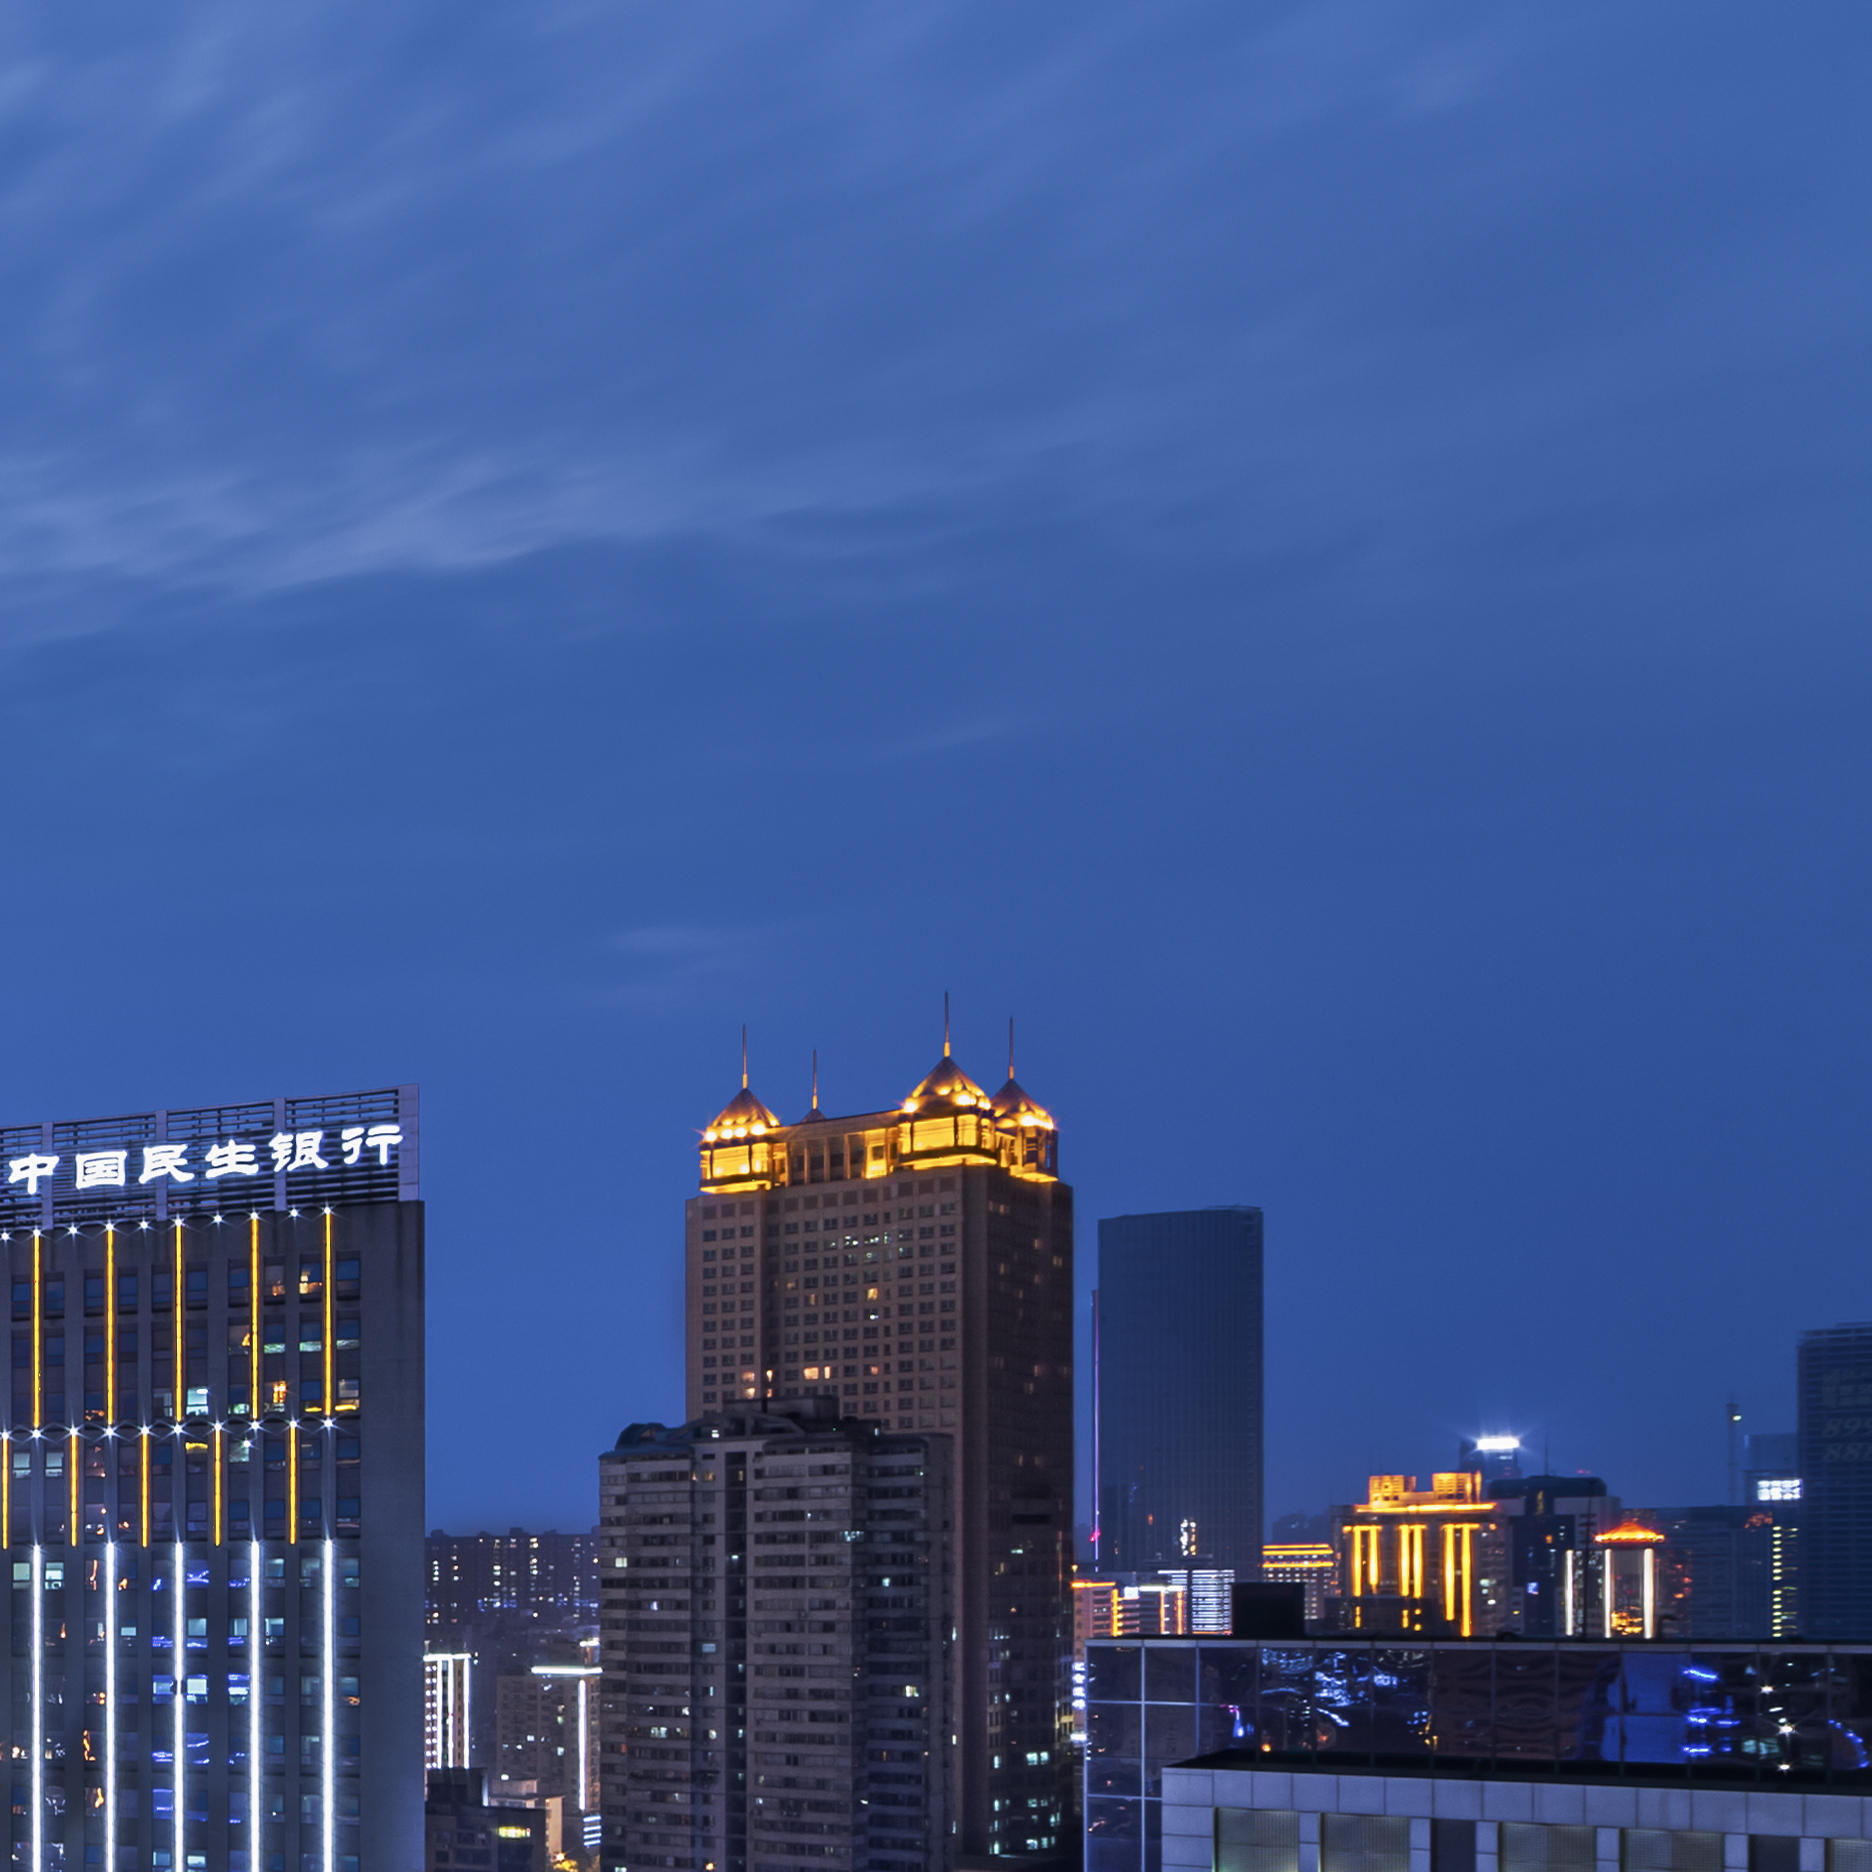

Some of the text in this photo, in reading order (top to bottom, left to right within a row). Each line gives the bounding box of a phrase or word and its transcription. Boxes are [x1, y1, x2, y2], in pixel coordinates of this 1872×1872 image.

[8, 1123, 405, 1197] 中国民生银行
